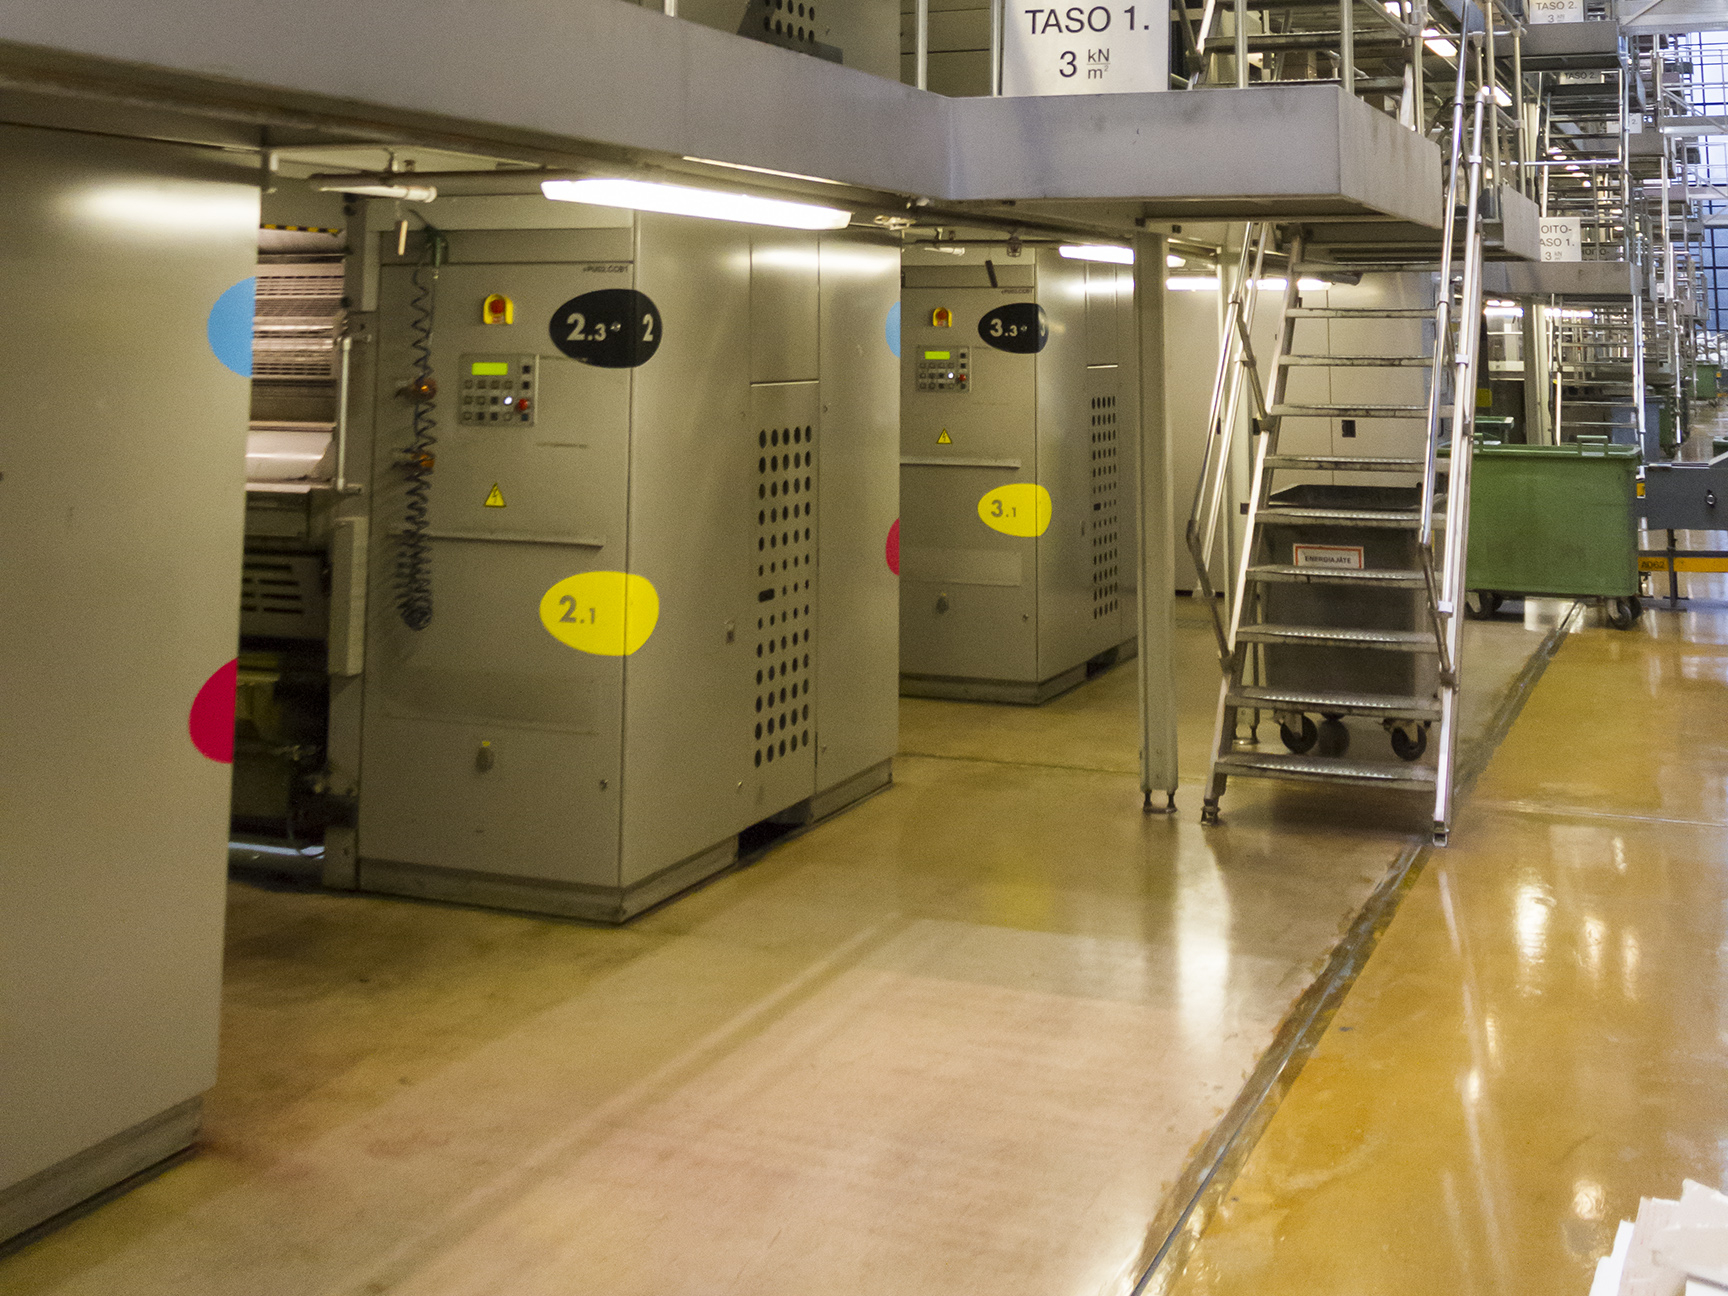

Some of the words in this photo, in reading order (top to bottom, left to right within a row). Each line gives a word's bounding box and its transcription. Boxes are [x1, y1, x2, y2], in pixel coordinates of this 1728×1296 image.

[1535, 1, 1565, 11] TASO
[1568, 0, 1578, 10] 2.
[1025, 6, 1112, 35] TASO
[1124, 5, 1150, 31] 1.
[1059, 51, 1078, 78] 3
[1087, 47, 1110, 63] kN
[1564, 71, 1588, 80] TASO
[1566, 238, 1575, 247] 1.
[1545, 251, 1552, 261] 3
[566, 312, 607, 342] 2.3
[642, 313, 654, 342] 2
[989, 317, 1019, 338] 3.3
[990, 499, 1017, 518] 3.1
[558, 594, 596, 624] 2.1
